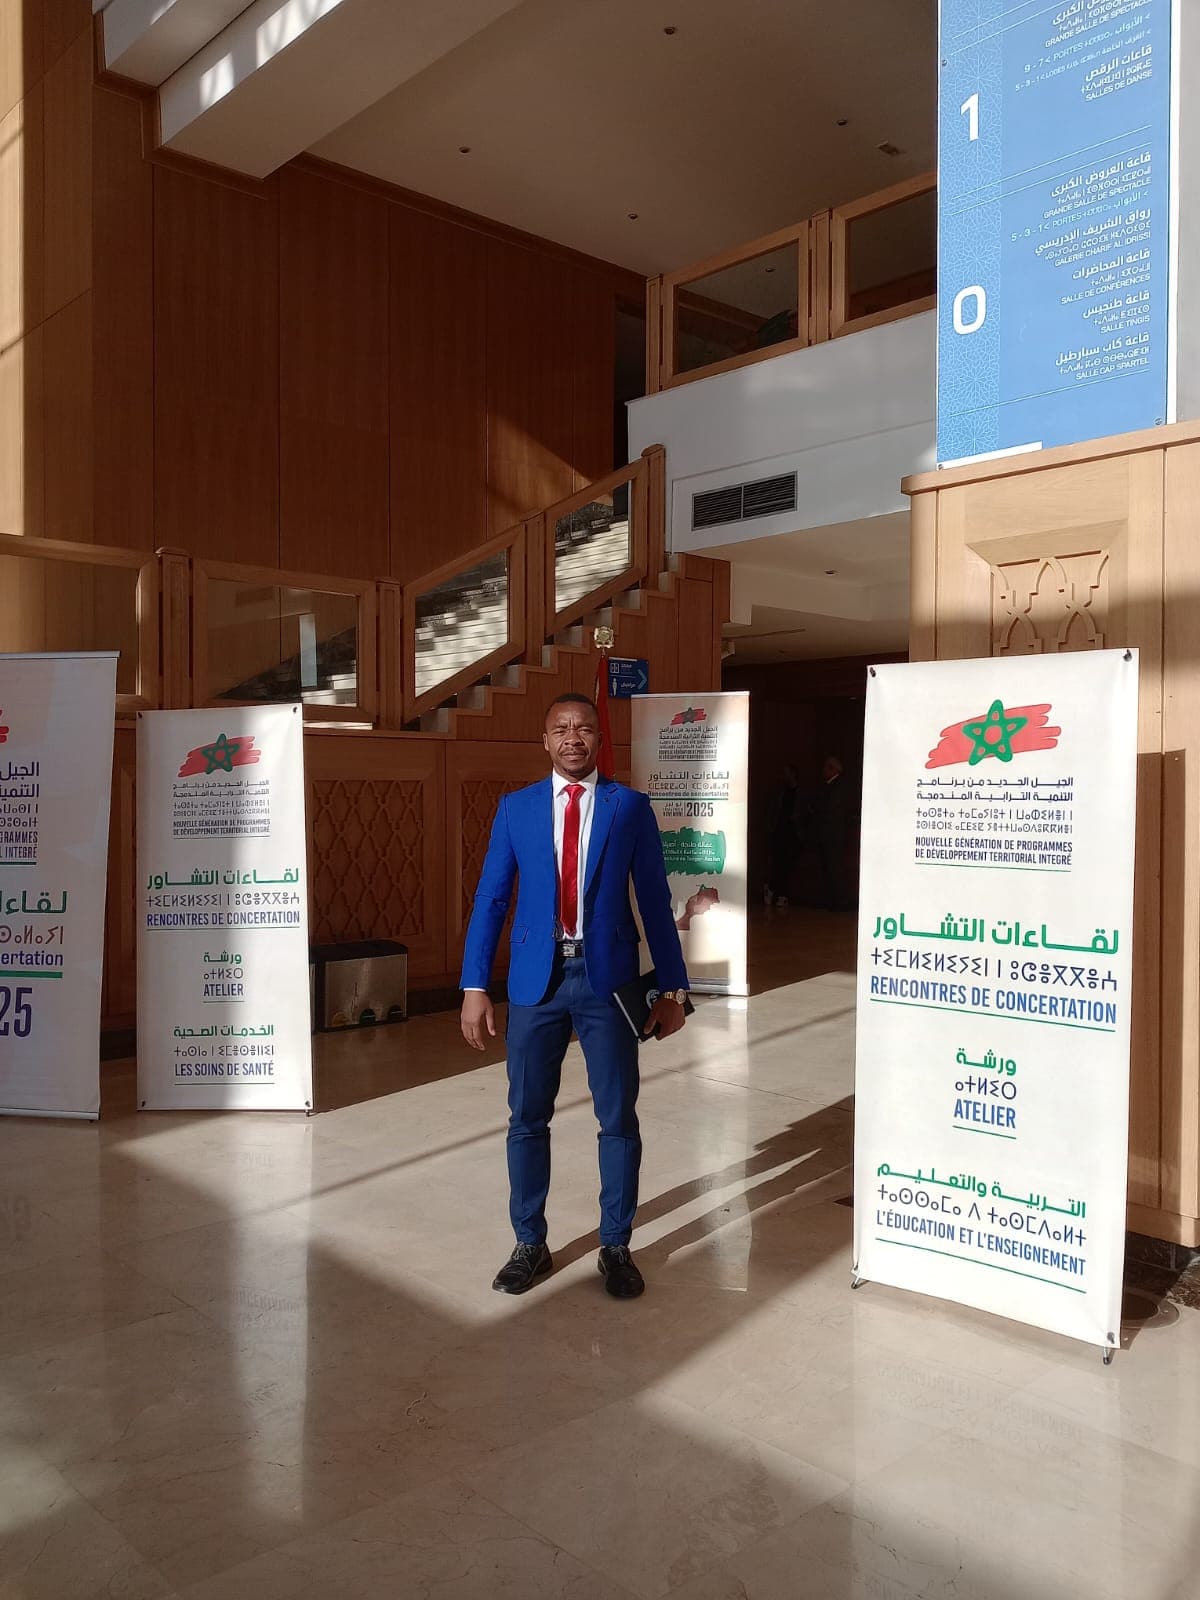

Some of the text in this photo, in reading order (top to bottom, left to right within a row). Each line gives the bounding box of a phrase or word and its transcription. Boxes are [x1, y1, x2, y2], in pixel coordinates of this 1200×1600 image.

[1045, 29, 1074, 48] GRANDE
[1075, 20, 1097, 35] SALLE
[1099, 15, 1110, 24] DE
[1121, 44, 1152, 65] قاعات
[1085, 57, 1119, 82] الرقص
[1085, 84, 1114, 102] SALLES
[1115, 80, 1125, 89] DE
[1126, 69, 1153, 86] DANSE
[960, 92, 979, 142] 1
[1126, 151, 1151, 169] قاعة
[1085, 161, 1124, 185] العروض
[1051, 176, 1082, 197] الكبرى
[1043, 204, 1072, 219] GRANDE
[1073, 198, 1097, 209] SALLE
[1108, 177, 1151, 197] SPECTACLE
[1082, 214, 1122, 236] الشريف
[1125, 208, 1151, 225] رواق
[1055, 231, 1151, 267] GALERIE CHARIF AL IDRISSI
[1126, 247, 1151, 264] قاعة
[1072, 255, 1124, 280] المحاضرات
[1061, 293, 1083, 305] SALLE
[1084, 288, 1095, 297] DE
[1096, 273, 1151, 295] CONFÉRENCES
[1125, 290, 1150, 305] قاعة
[953, 284, 986, 335] 0
[1101, 322, 1124, 334] SALLE
[1125, 315, 1150, 327] TINGIS
[1125, 332, 1150, 346] قاعة
[1055, 346, 1100, 366] سبارطيل
[1076, 357, 1149, 380] SALLE CAP SPARTEL
[916, 777, 1074, 789] الجيل الجديد من برنامج
[917, 791, 1073, 803] التنمية الترابية المندمجة
[687, 802, 714, 817] 2025
[915, 836, 1073, 853] NOUVELLE GÉNÉRATION DE PROGRAMMES
[915, 847, 1072, 866] DE DÉVELOPPEMENT TERRITORIAL INTEGRÉ
[146, 868, 299, 890] لقاءات التشاور
[146, 910, 300, 927] RENCONTRES DE CONCERTATION
[872, 912, 1120, 955] لقاءات التشاور
[203, 950, 242, 964] ورشة
[203, 983, 244, 997] ATELIER
[870, 975, 1117, 1025] RENCONTRES DE CONCERTATION
[173, 1024, 274, 1039] الخدمات الصحية
[175, 1060, 274, 1077] LES SOINS DE SANTÉ
[956, 1047, 1017, 1077] ورشة
[953, 1098, 1017, 1129] ATELIER
[877, 1163, 1086, 1218] التربية والتعليم
[876, 1208, 1087, 1276] L'ÉDUCATION ET L'ENSEIGNEMENT
